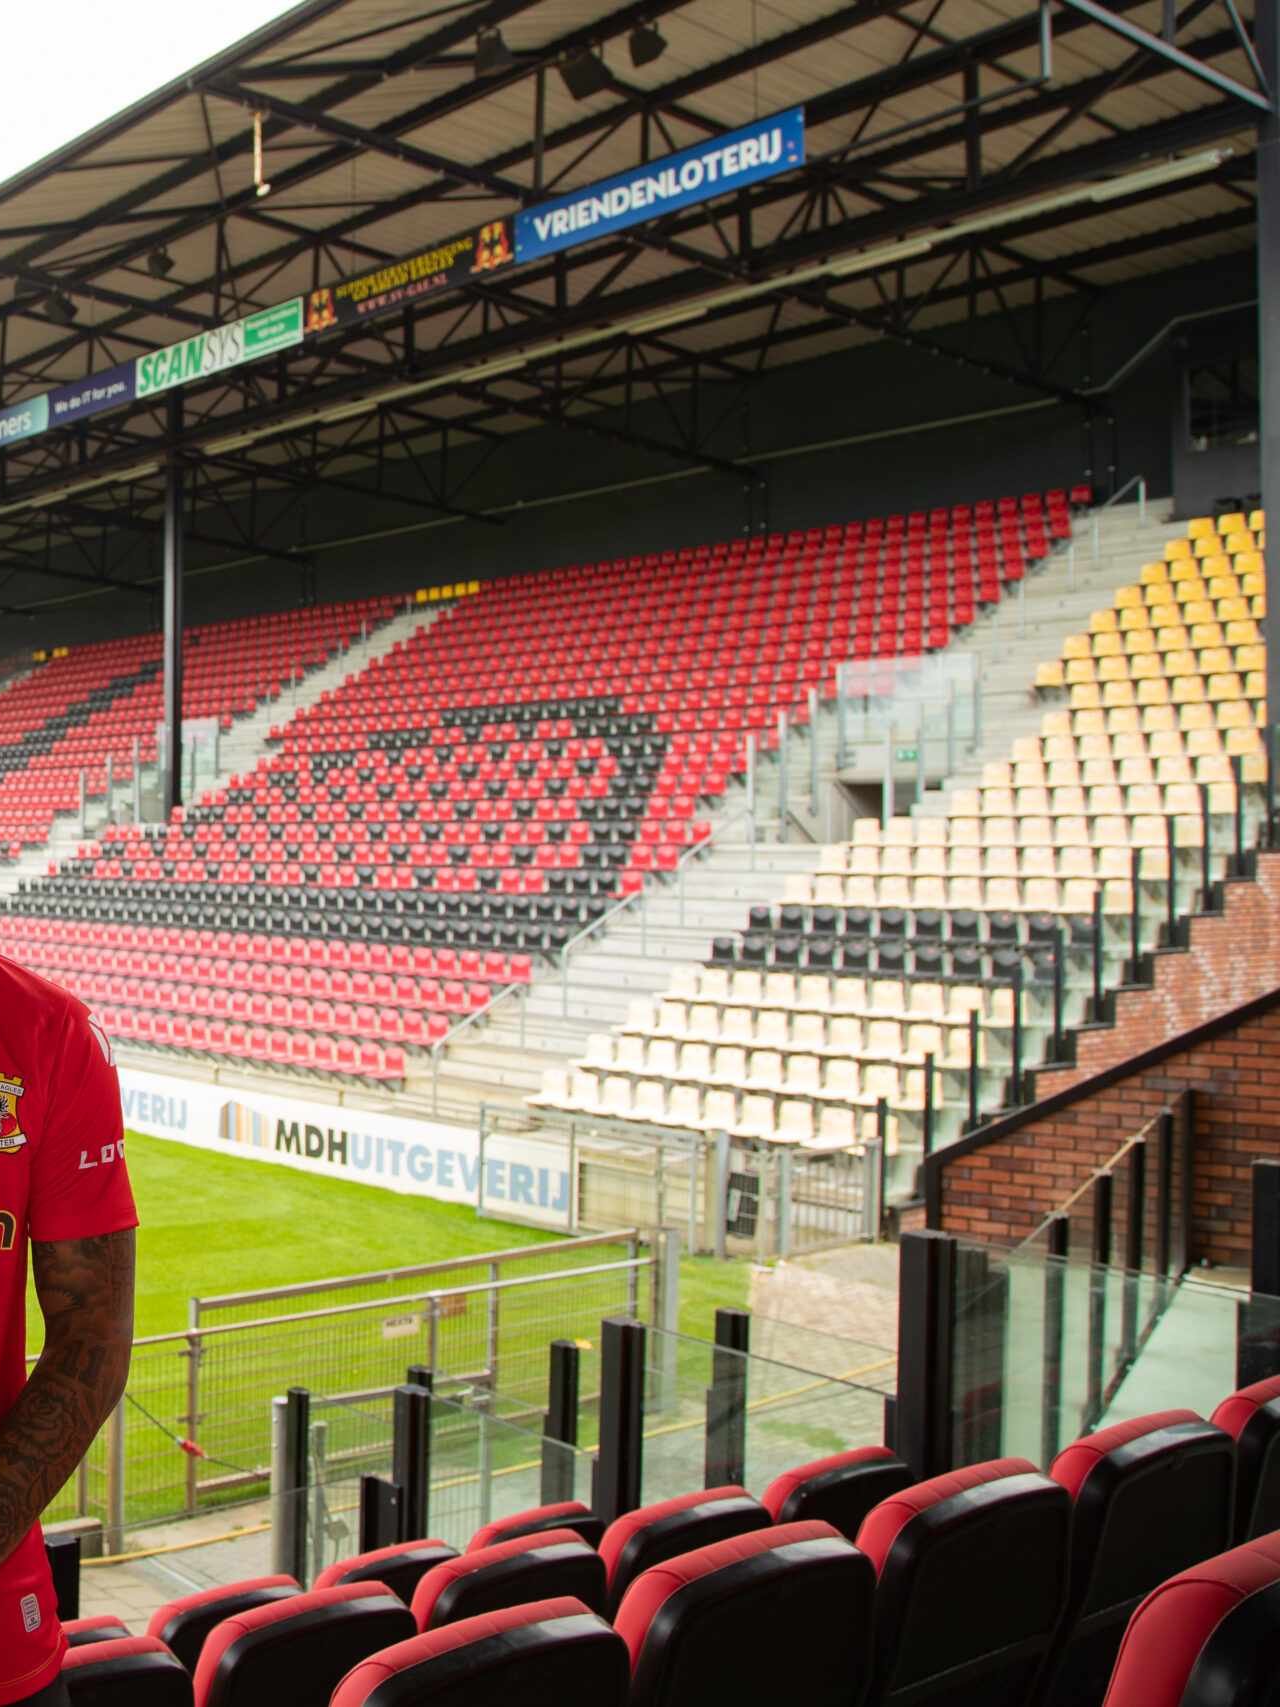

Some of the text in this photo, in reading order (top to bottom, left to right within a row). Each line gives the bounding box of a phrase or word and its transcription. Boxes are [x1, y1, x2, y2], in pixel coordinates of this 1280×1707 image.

[533, 129, 782, 241] VRIENDENLOTERIJ
[140, 320, 242, 391] SCANSYS
[55, 401, 68, 414] We
[69, 397, 81, 410] do
[106, 382, 127, 400] you.
